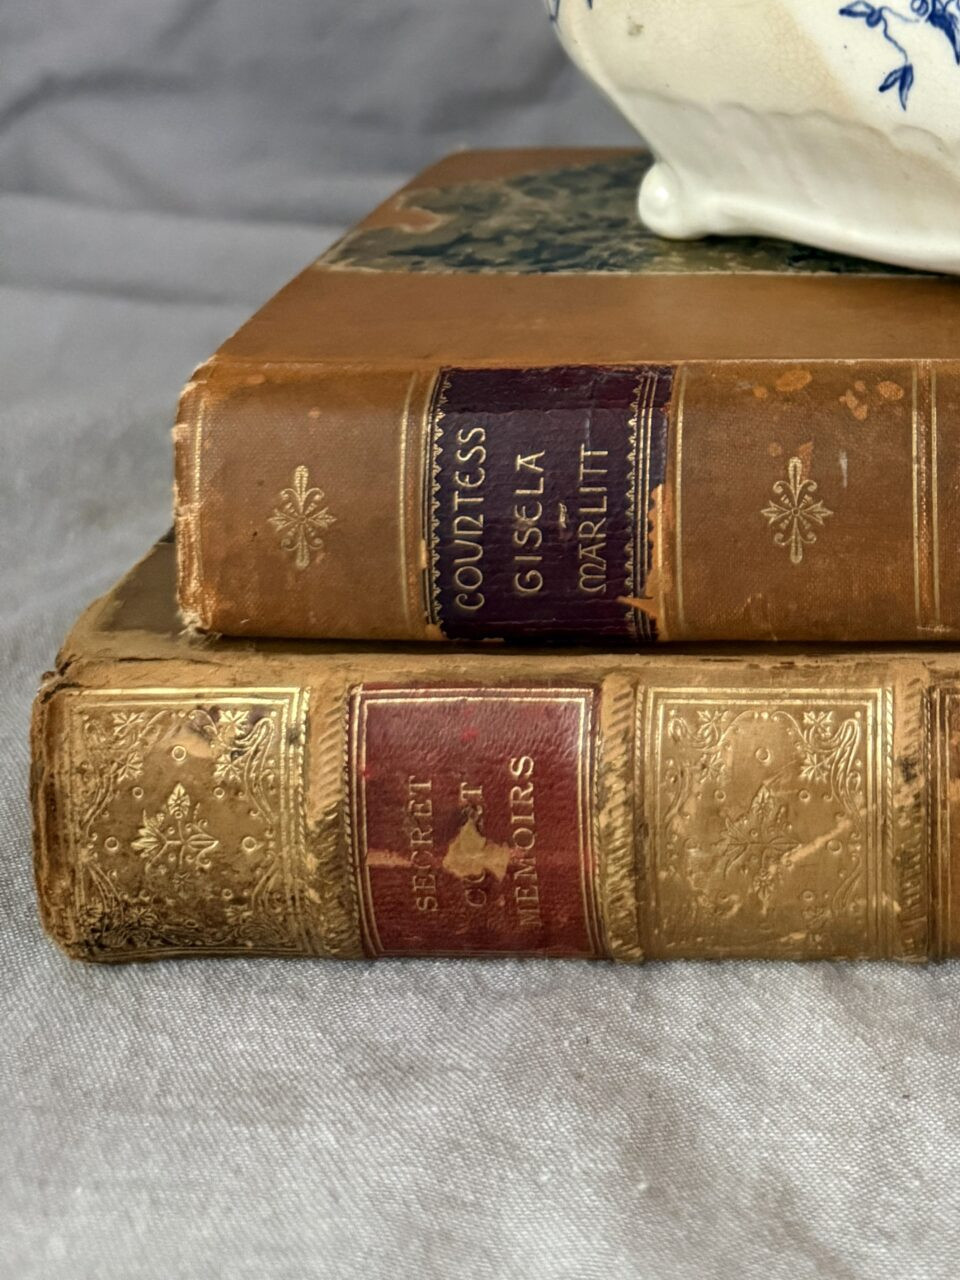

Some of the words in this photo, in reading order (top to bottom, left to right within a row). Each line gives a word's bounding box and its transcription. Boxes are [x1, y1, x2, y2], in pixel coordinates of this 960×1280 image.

[454, 426, 487, 611] COUNTESS
[513, 449, 546, 593] GISELA
[578, 443, 609, 594] MARLITT
[408, 775, 439, 913] SECRET
[509, 755, 543, 927] MEMOIRS
